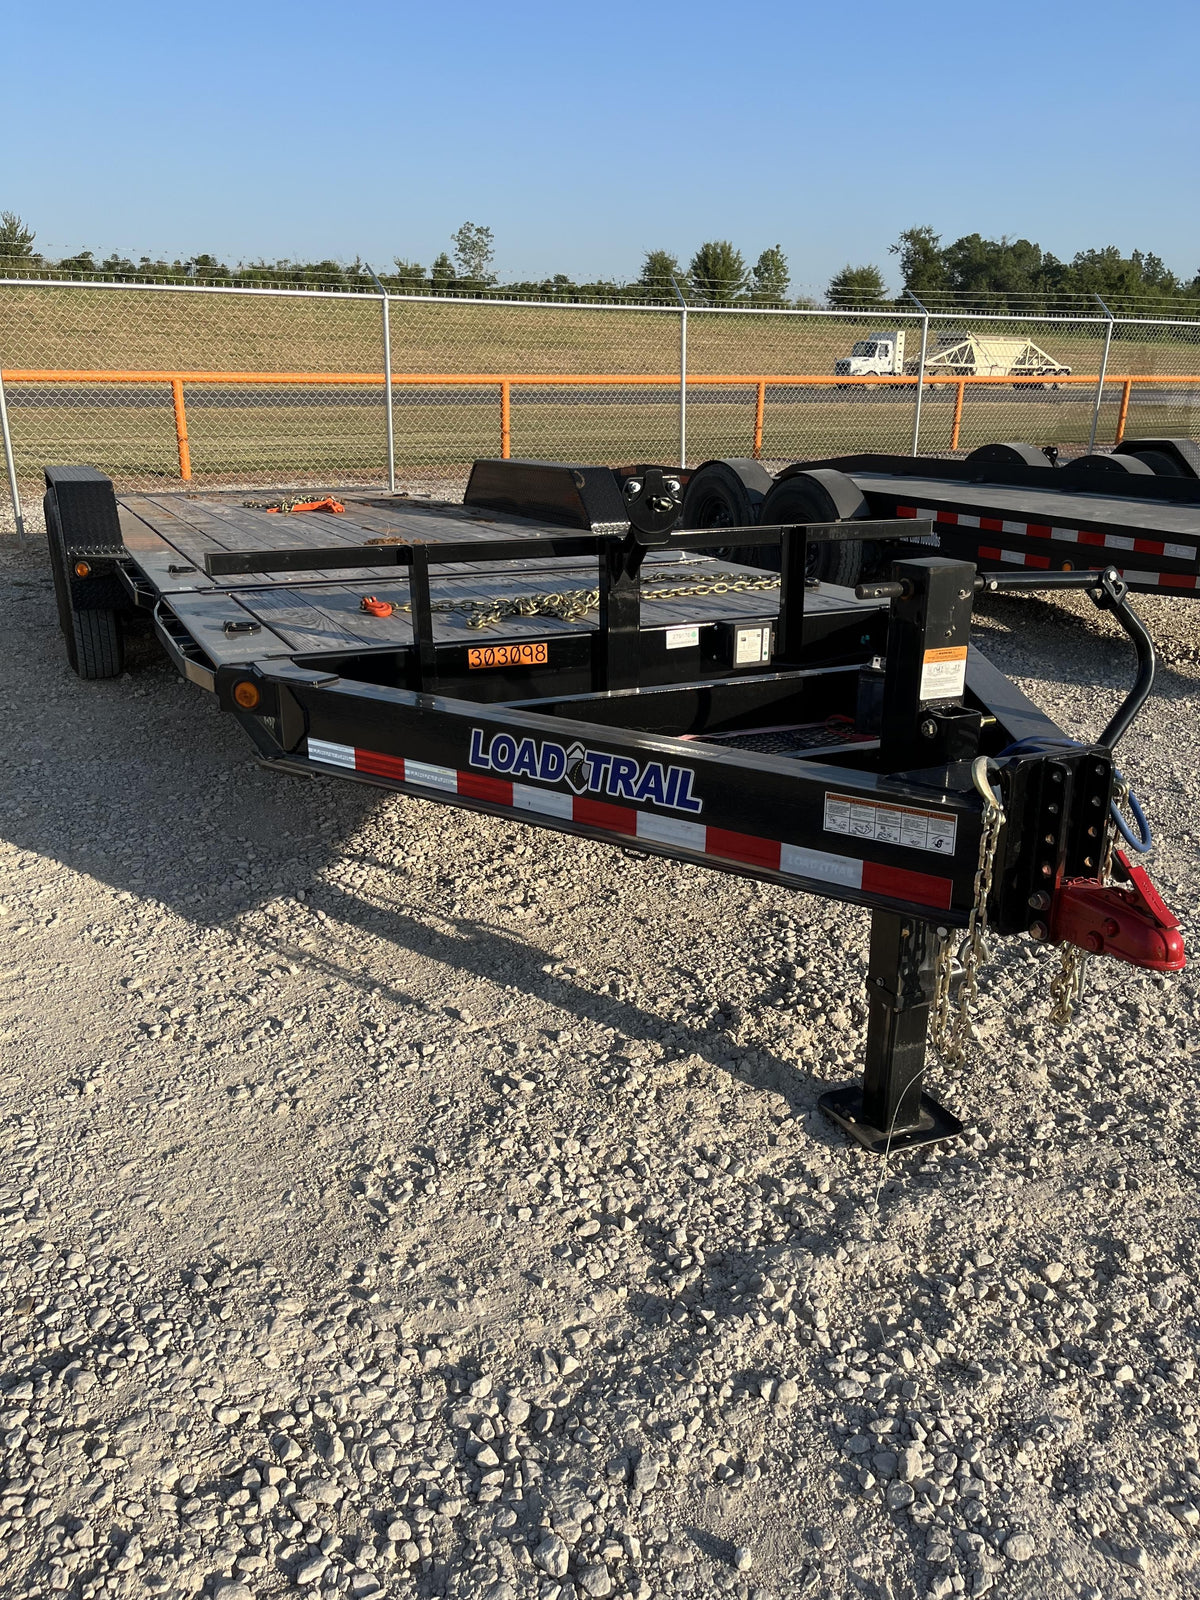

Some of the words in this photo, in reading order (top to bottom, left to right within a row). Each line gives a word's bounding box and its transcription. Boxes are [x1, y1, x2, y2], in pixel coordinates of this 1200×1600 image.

[471, 644, 546, 668] 303098
[469, 729, 567, 783] LOAD
[584, 750, 703, 813] TRAIL
